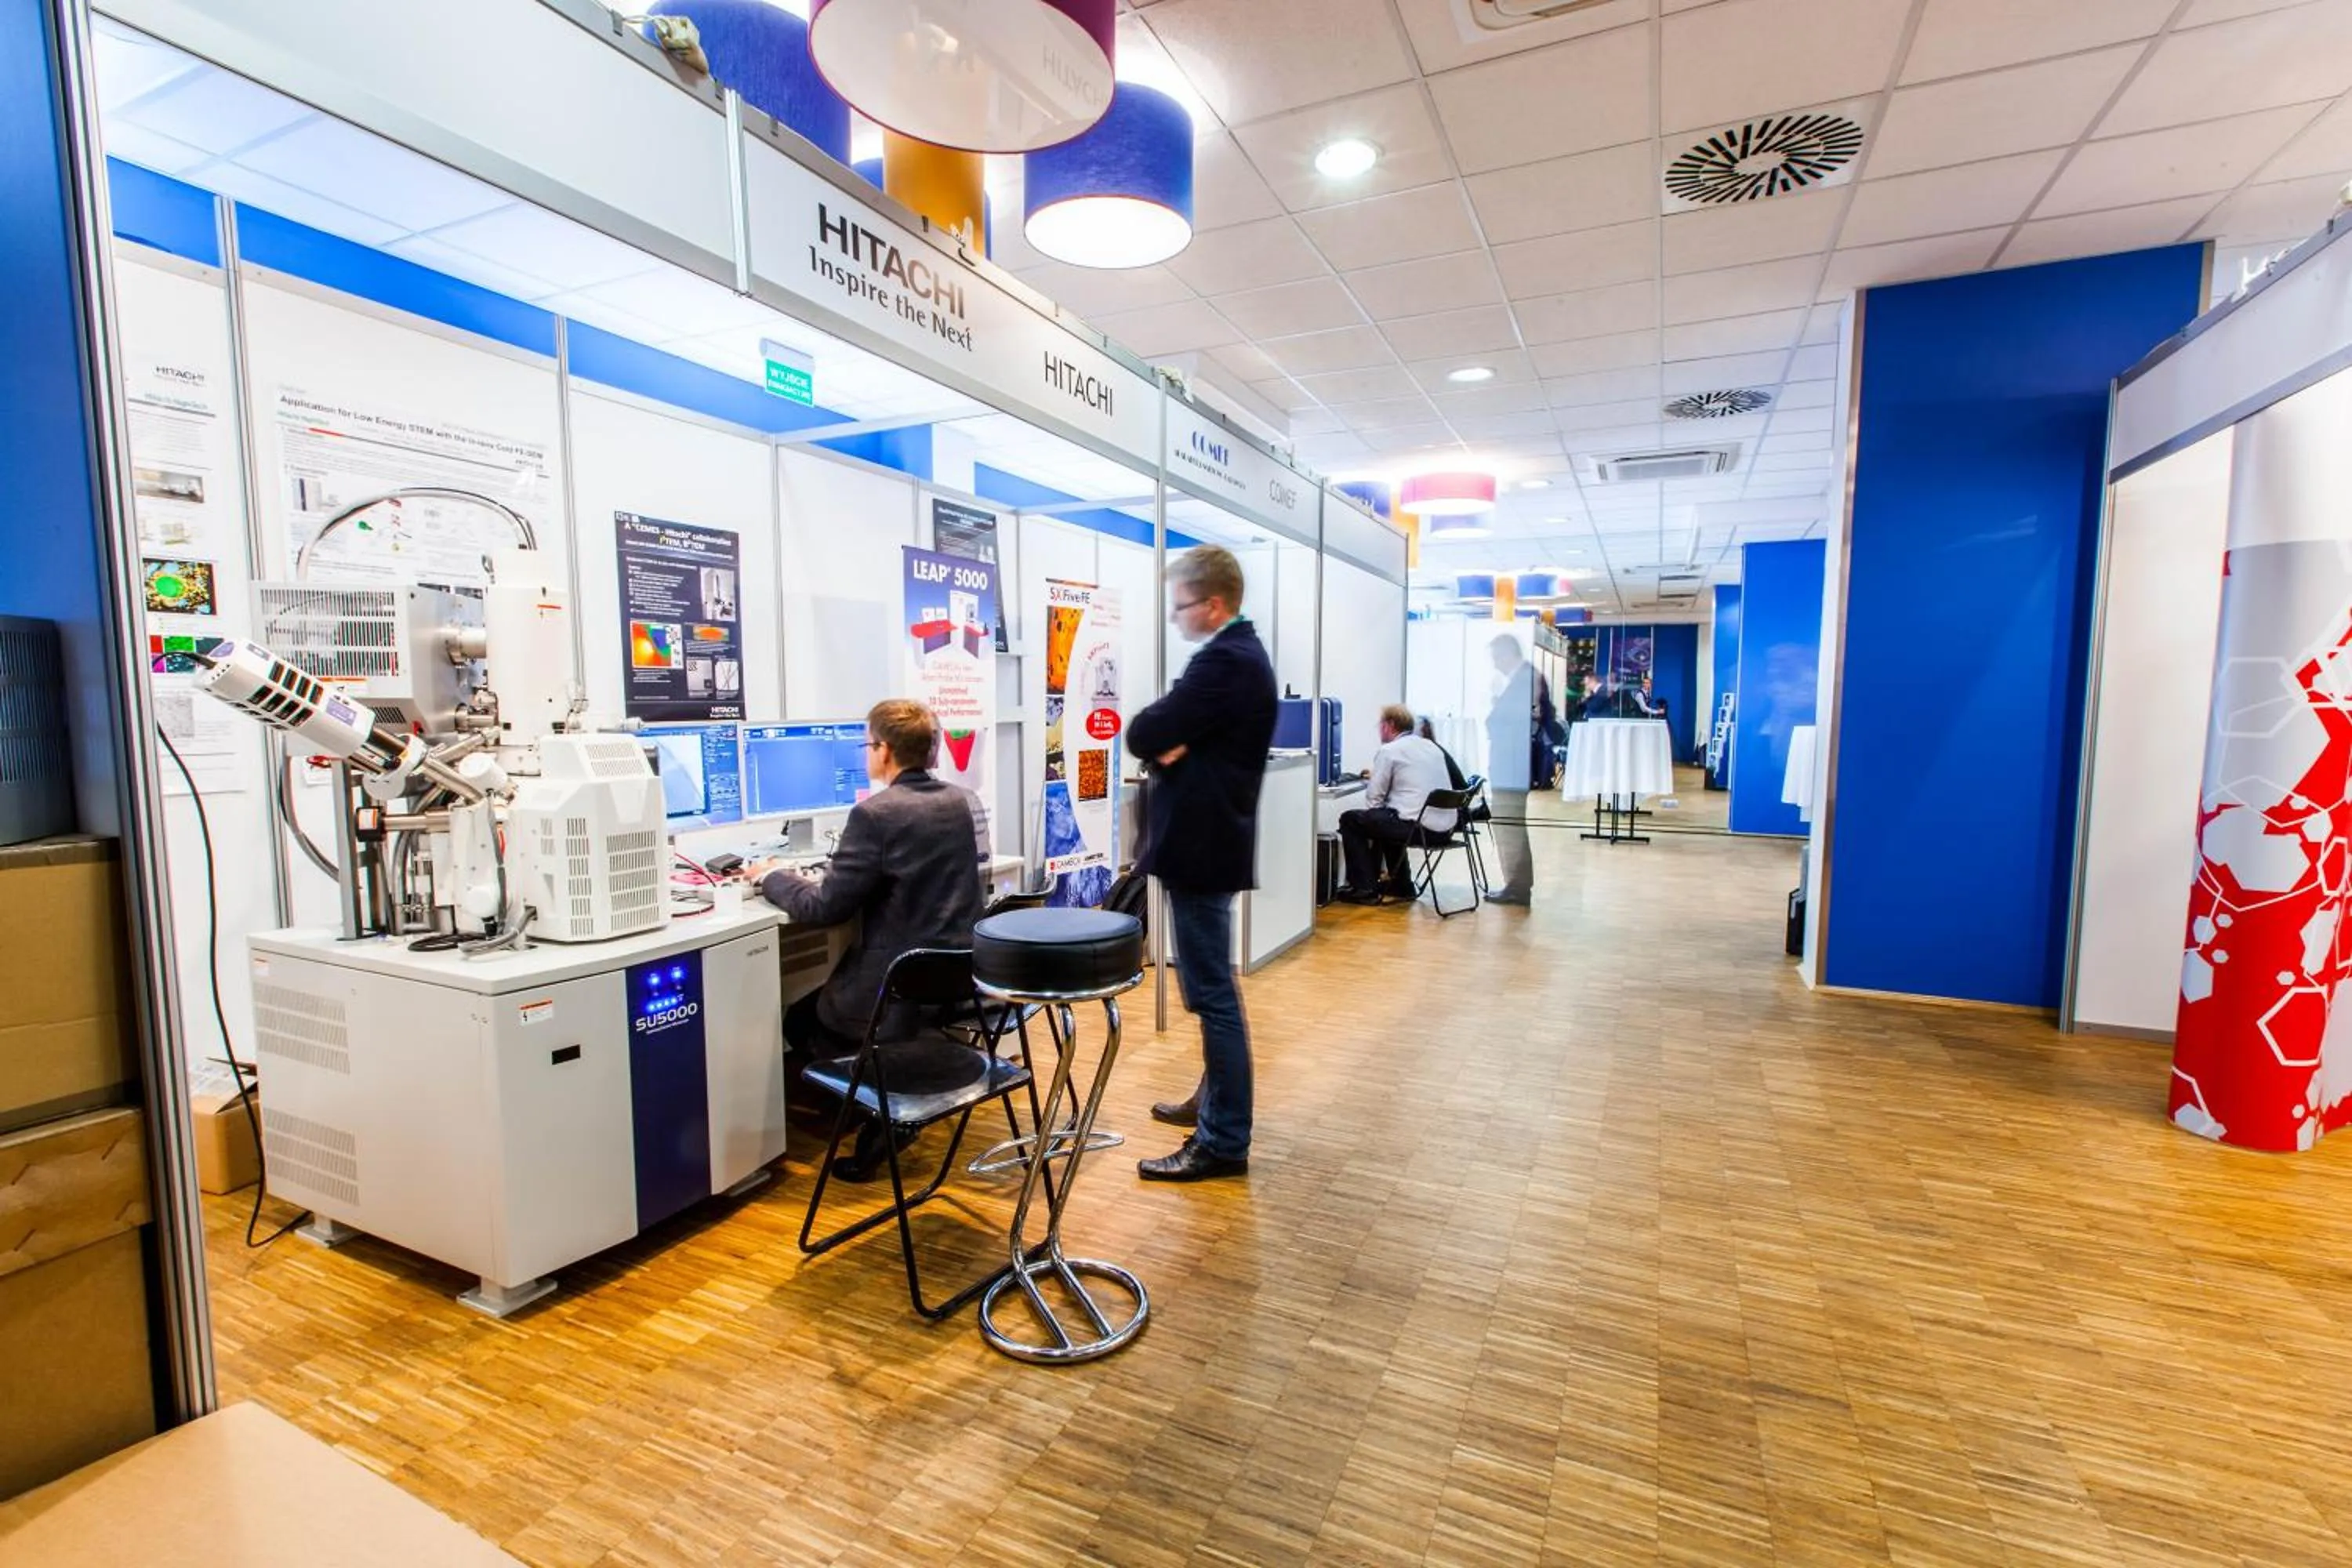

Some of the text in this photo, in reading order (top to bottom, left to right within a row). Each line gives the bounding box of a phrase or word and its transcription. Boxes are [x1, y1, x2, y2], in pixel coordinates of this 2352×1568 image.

[818, 201, 965, 320] HITACHI
[809, 245, 972, 352] Inspire the Next
[156, 366, 205, 382] HITACHI
[1044, 350, 1112, 417] HITACHI
[280, 394, 336, 413] Application
[338, 407, 351, 418] for
[354, 412, 373, 423] Low
[376, 416, 407, 431] Energy
[954, 567, 988, 590] 5000
[635, 1002, 698, 1032] SU5000
